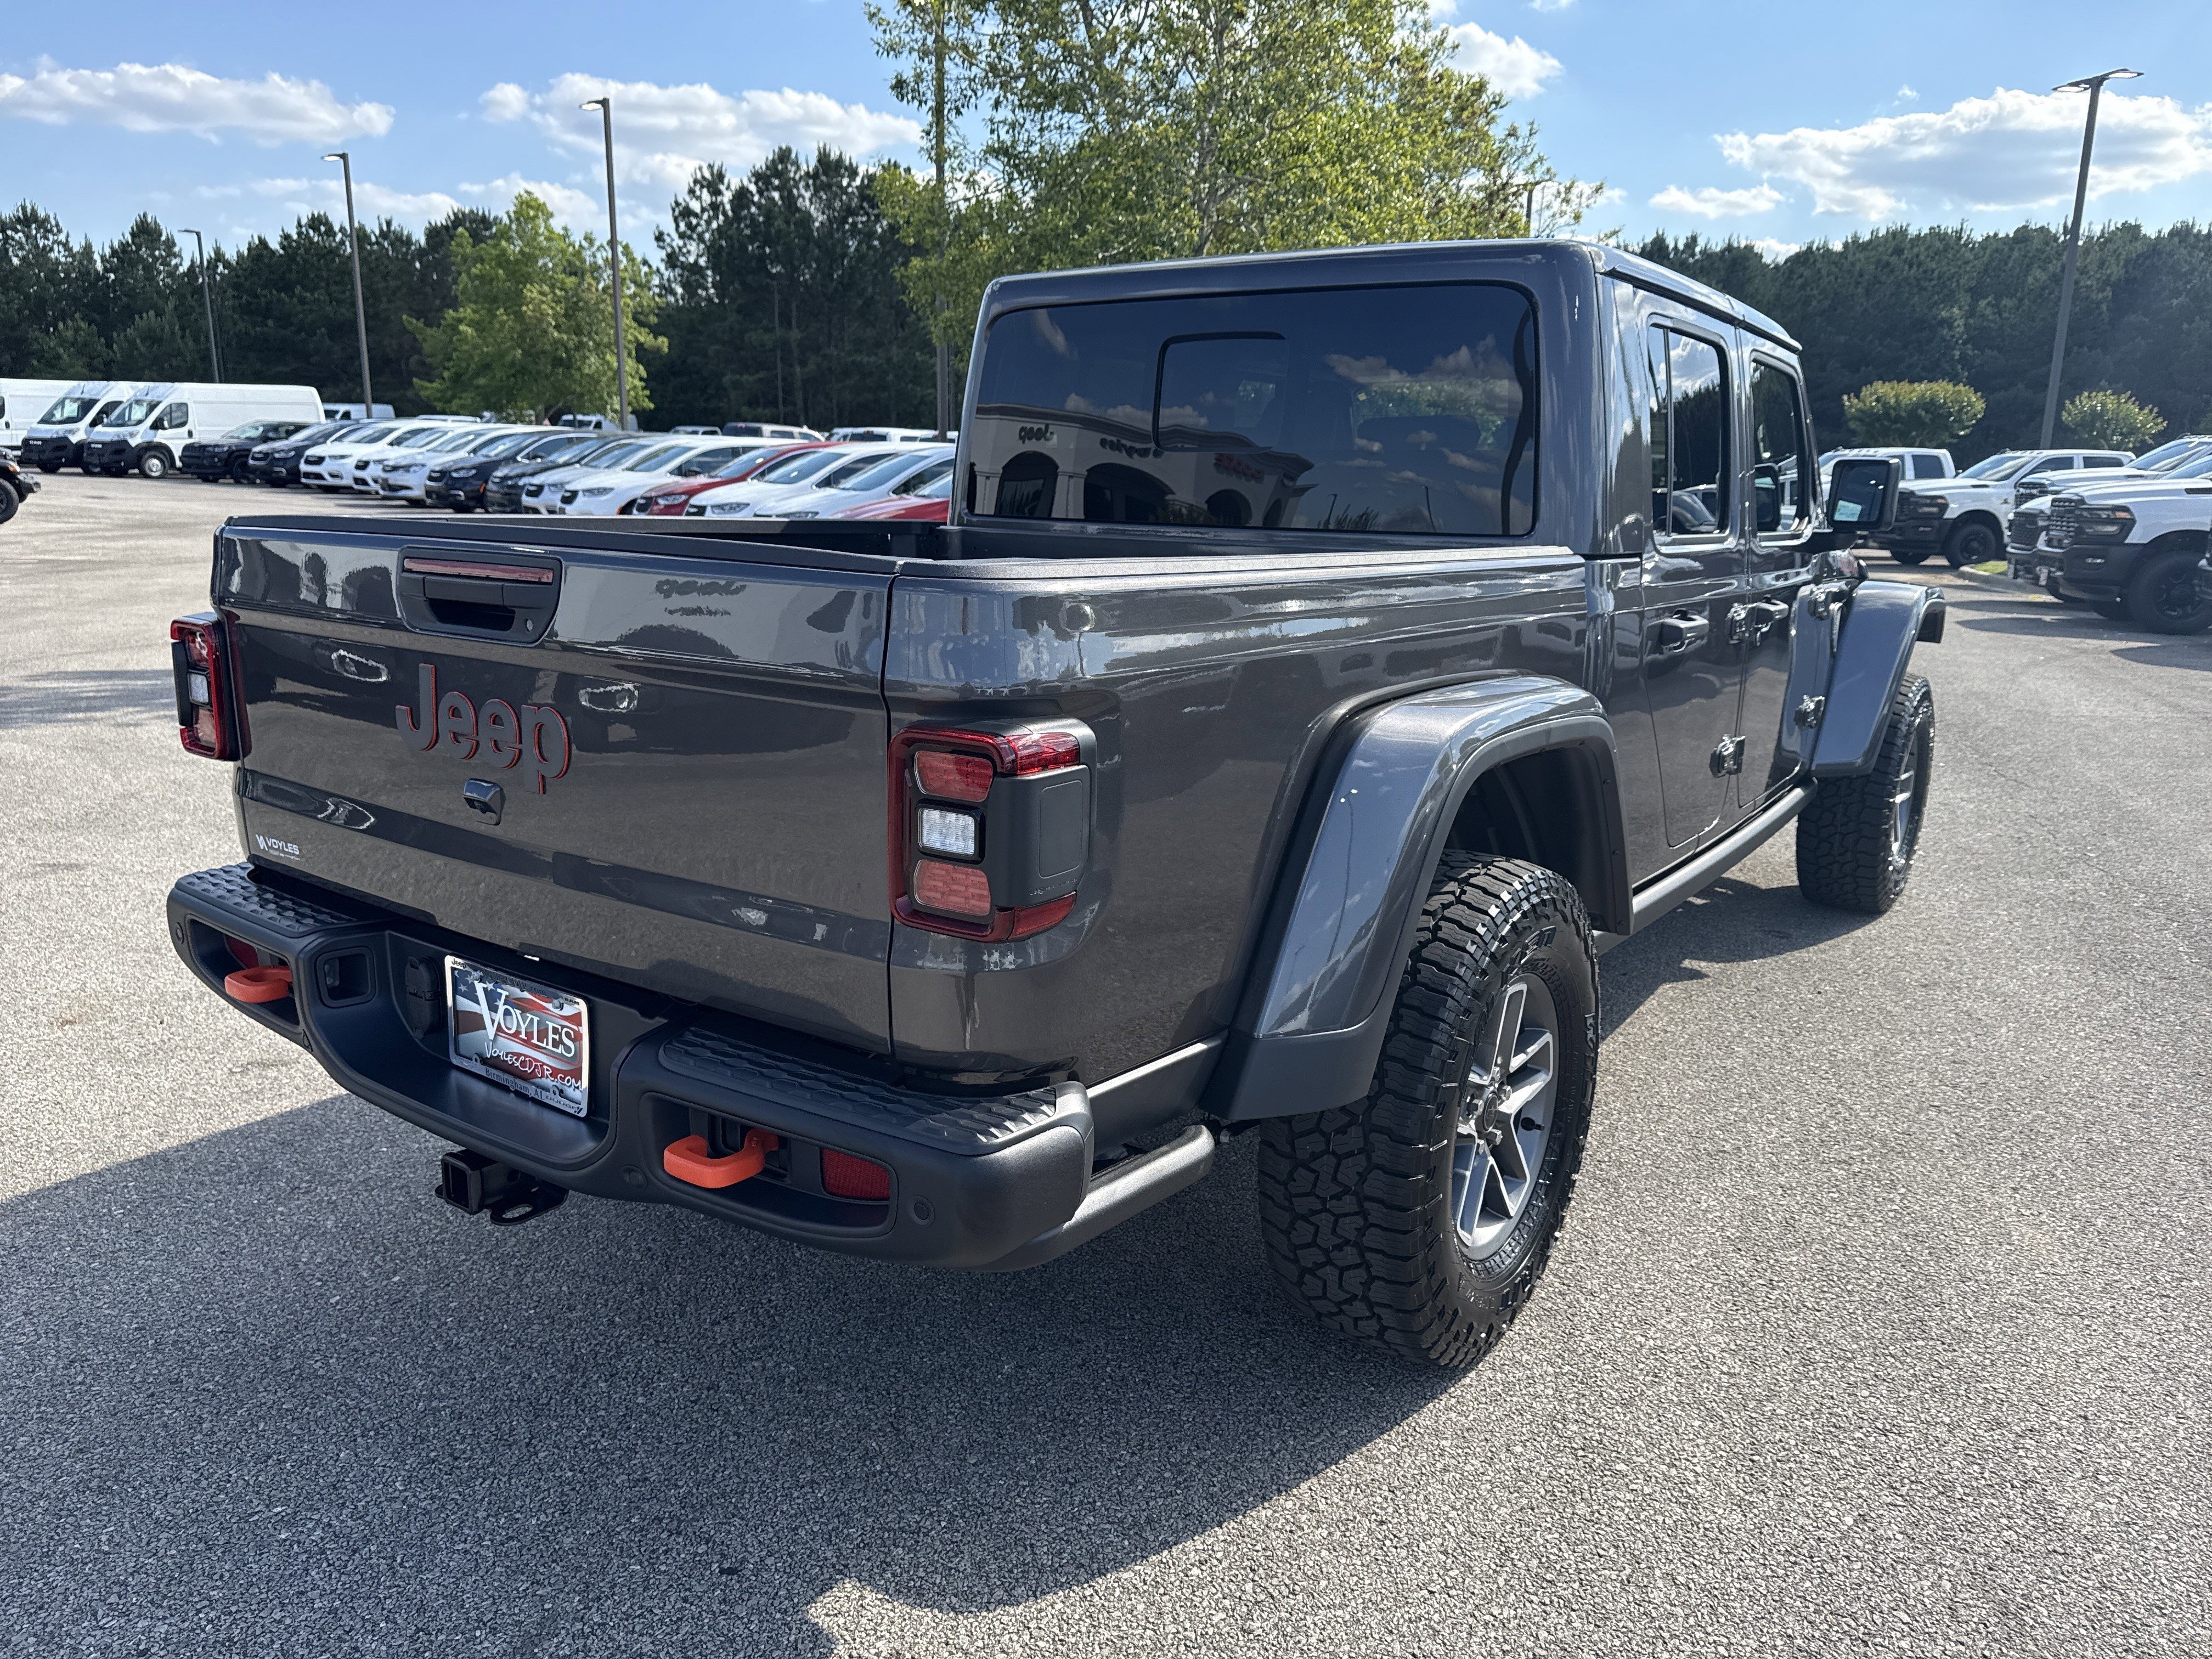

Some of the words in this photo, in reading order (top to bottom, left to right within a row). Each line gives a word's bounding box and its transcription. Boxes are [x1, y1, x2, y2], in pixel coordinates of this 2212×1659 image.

[395, 663, 572, 795] Jeep
[266, 837, 300, 855] VOYLES
[451, 958, 467, 969] Jeep
[564, 996, 580, 1006] RAM
[474, 980, 575, 1058] VOYLES
[485, 1067, 532, 1097] Birmingham,
[534, 1088, 545, 1101] AL
